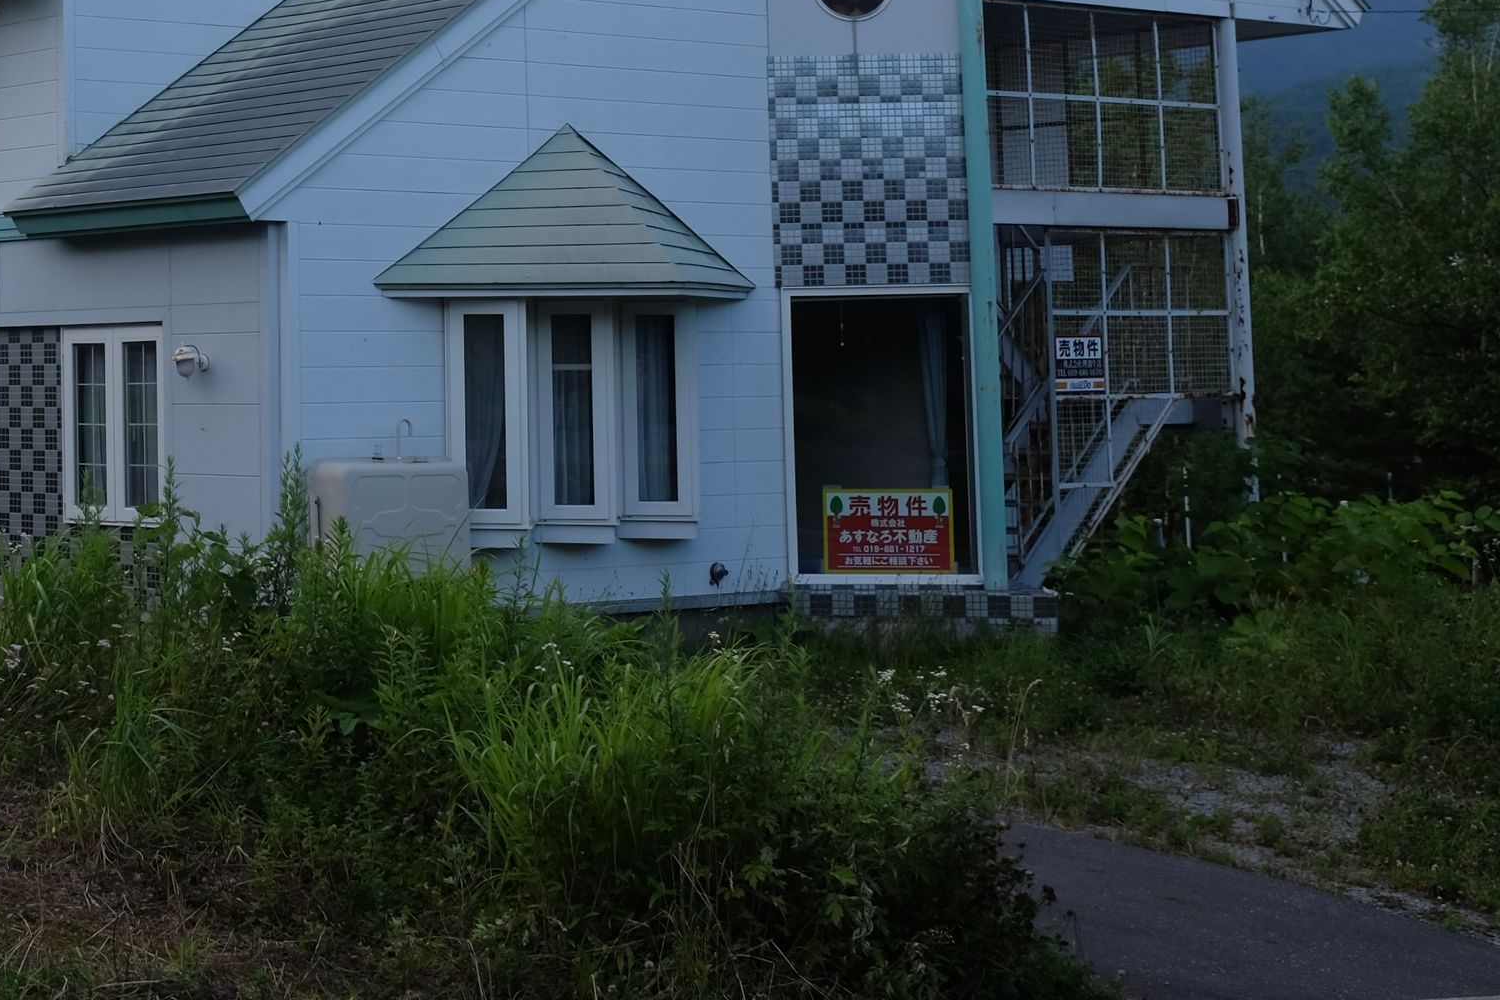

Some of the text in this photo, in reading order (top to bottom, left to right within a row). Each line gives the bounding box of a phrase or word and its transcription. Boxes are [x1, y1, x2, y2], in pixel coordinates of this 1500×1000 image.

[1059, 339, 1099, 357] 売物件
[848, 495, 928, 517] 売物件
[870, 518, 906, 528] 株式会社
[839, 529, 938, 545] あすなろ不動産
[844, 556, 934, 566] お気軽にご相談下さい
